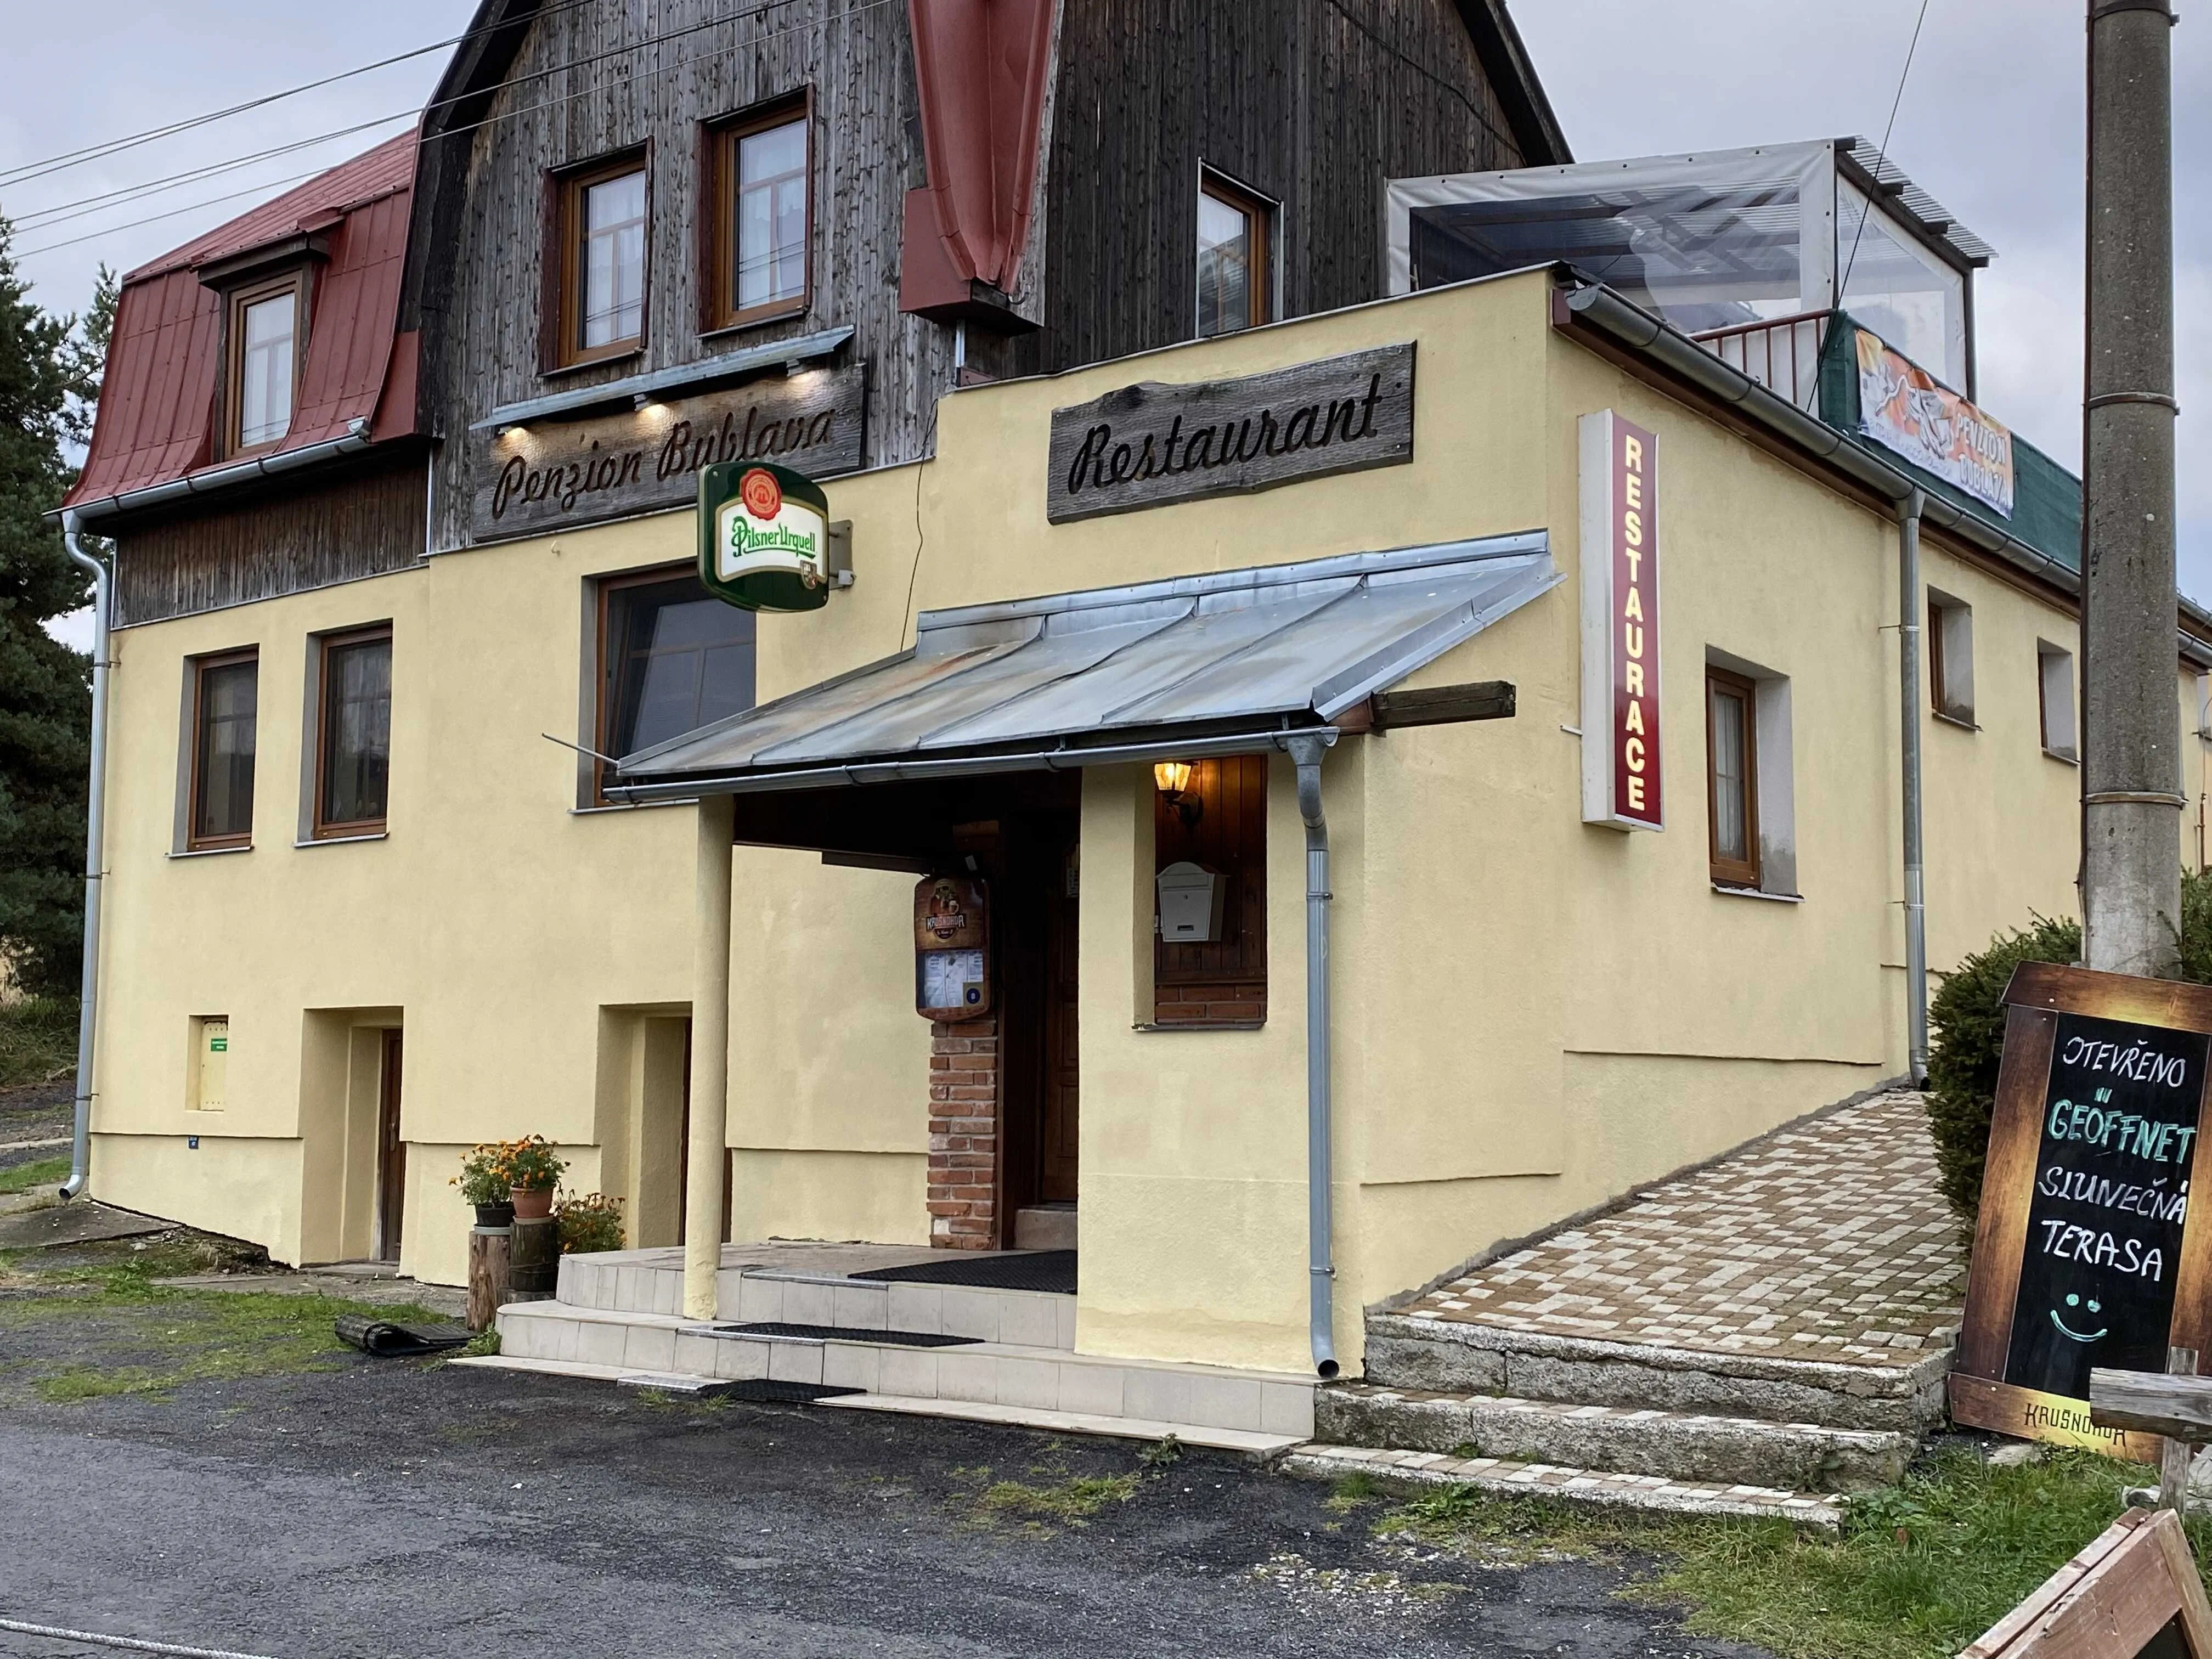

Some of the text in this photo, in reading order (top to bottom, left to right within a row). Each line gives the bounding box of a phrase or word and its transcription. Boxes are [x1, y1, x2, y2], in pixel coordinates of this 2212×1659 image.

[492, 406, 836, 519] Penzion Bublava
[1068, 372, 1383, 494] Restaurant
[731, 516, 816, 557] Pilsner Urquell
[1624, 435, 1645, 811] RESTAURACE
[2063, 1036, 2186, 1087] OTEVŘENO
[2049, 1087, 2197, 1164] GEÖFFNET
[2038, 1166, 2189, 1224] SLUNEČNÁ
[2041, 1220, 2162, 1282] TERASA
